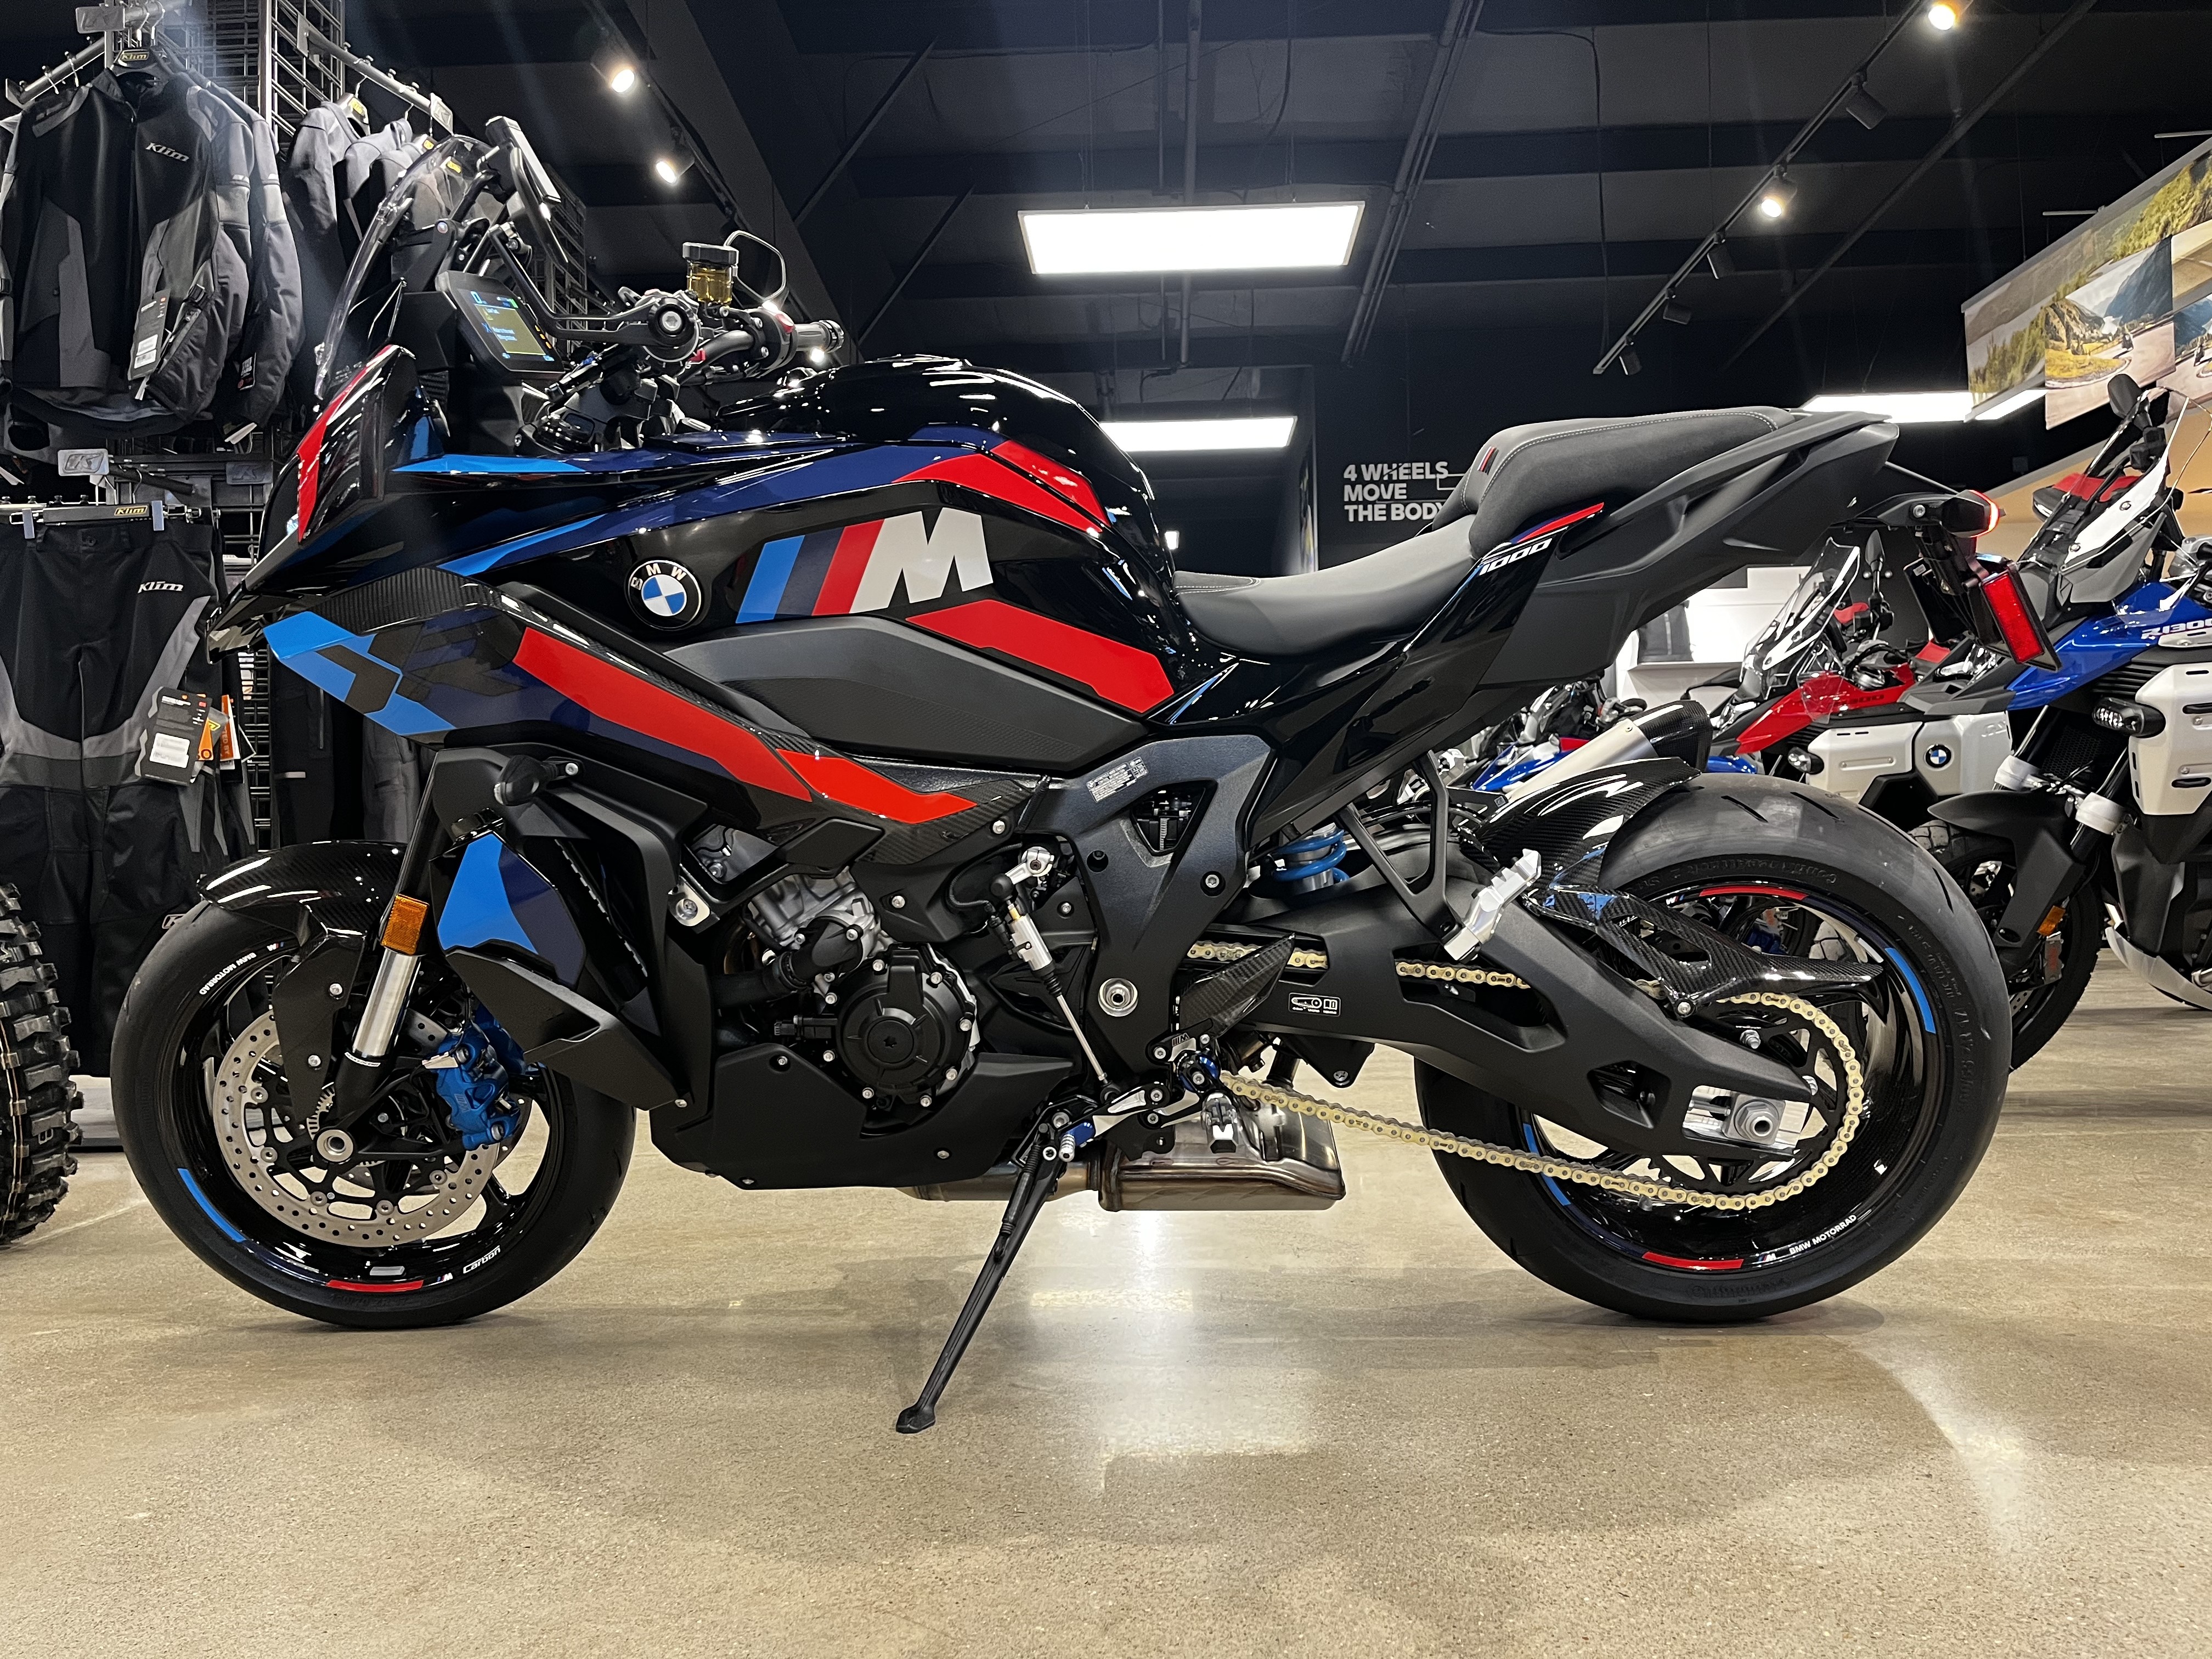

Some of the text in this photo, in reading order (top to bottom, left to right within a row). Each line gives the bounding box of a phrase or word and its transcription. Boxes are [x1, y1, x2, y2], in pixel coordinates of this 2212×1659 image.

[145, 142, 189, 162] Klim
[1343, 461, 1448, 481] 4 WHEELS
[1344, 483, 1407, 501] MOVE
[116, 507, 146, 515] Klim
[1344, 504, 1387, 522] THE
[849, 507, 994, 614] M
[1479, 538, 1553, 575] 1000
[630, 563, 687, 590] BMW
[138, 581, 184, 594] Klim
[236, 952, 257, 966] BMW
[199, 963, 236, 995] MOTORRAD
[1789, 1240, 1811, 1255] BMW
[1812, 1215, 1857, 1245] MOTORRAD
[463, 1245, 501, 1274] Carbon
